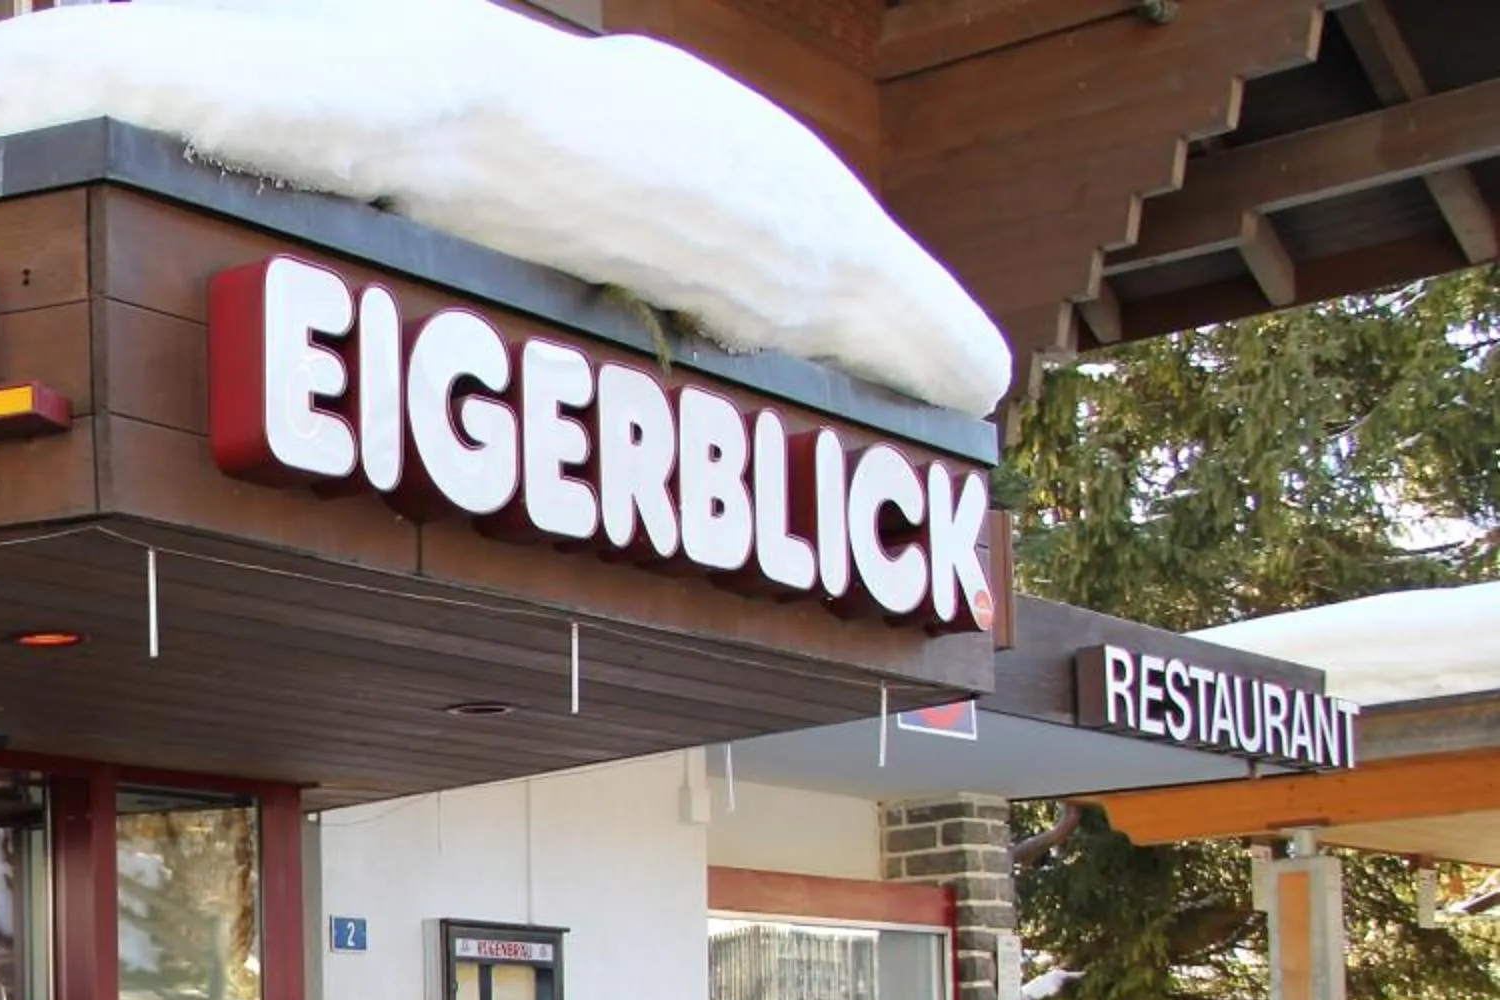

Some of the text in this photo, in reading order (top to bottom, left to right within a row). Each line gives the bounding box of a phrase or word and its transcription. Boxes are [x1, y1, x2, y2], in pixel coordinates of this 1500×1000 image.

[263, 256, 994, 630] EIGERBLICK
[1104, 644, 1360, 768] RESTAURANT
[347, 921, 356, 947] 2
